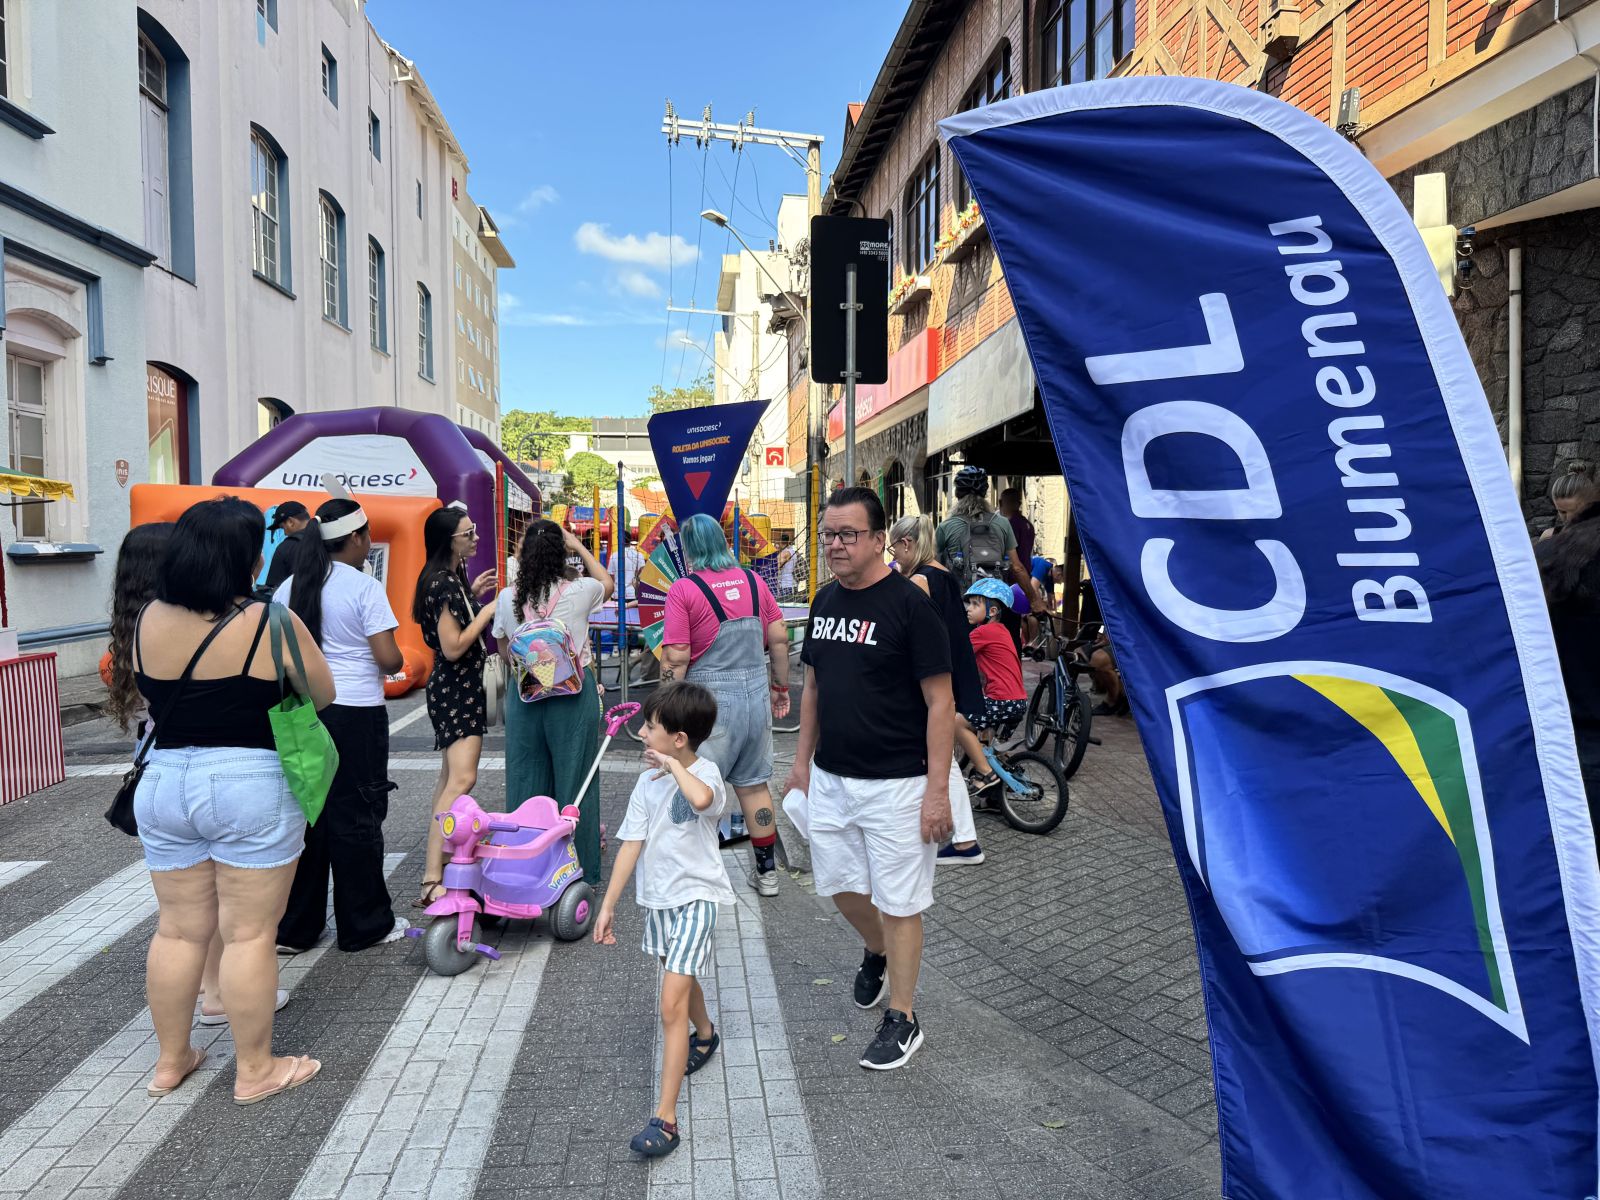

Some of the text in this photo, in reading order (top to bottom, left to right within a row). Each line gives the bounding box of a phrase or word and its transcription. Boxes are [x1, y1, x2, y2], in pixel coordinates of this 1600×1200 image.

[682, 453, 716, 465] Vamos jogar?
[1084, 292, 1307, 643] CDL
[1268, 215, 1433, 623] Blumenau
[811, 616, 878, 646] BRASIL
